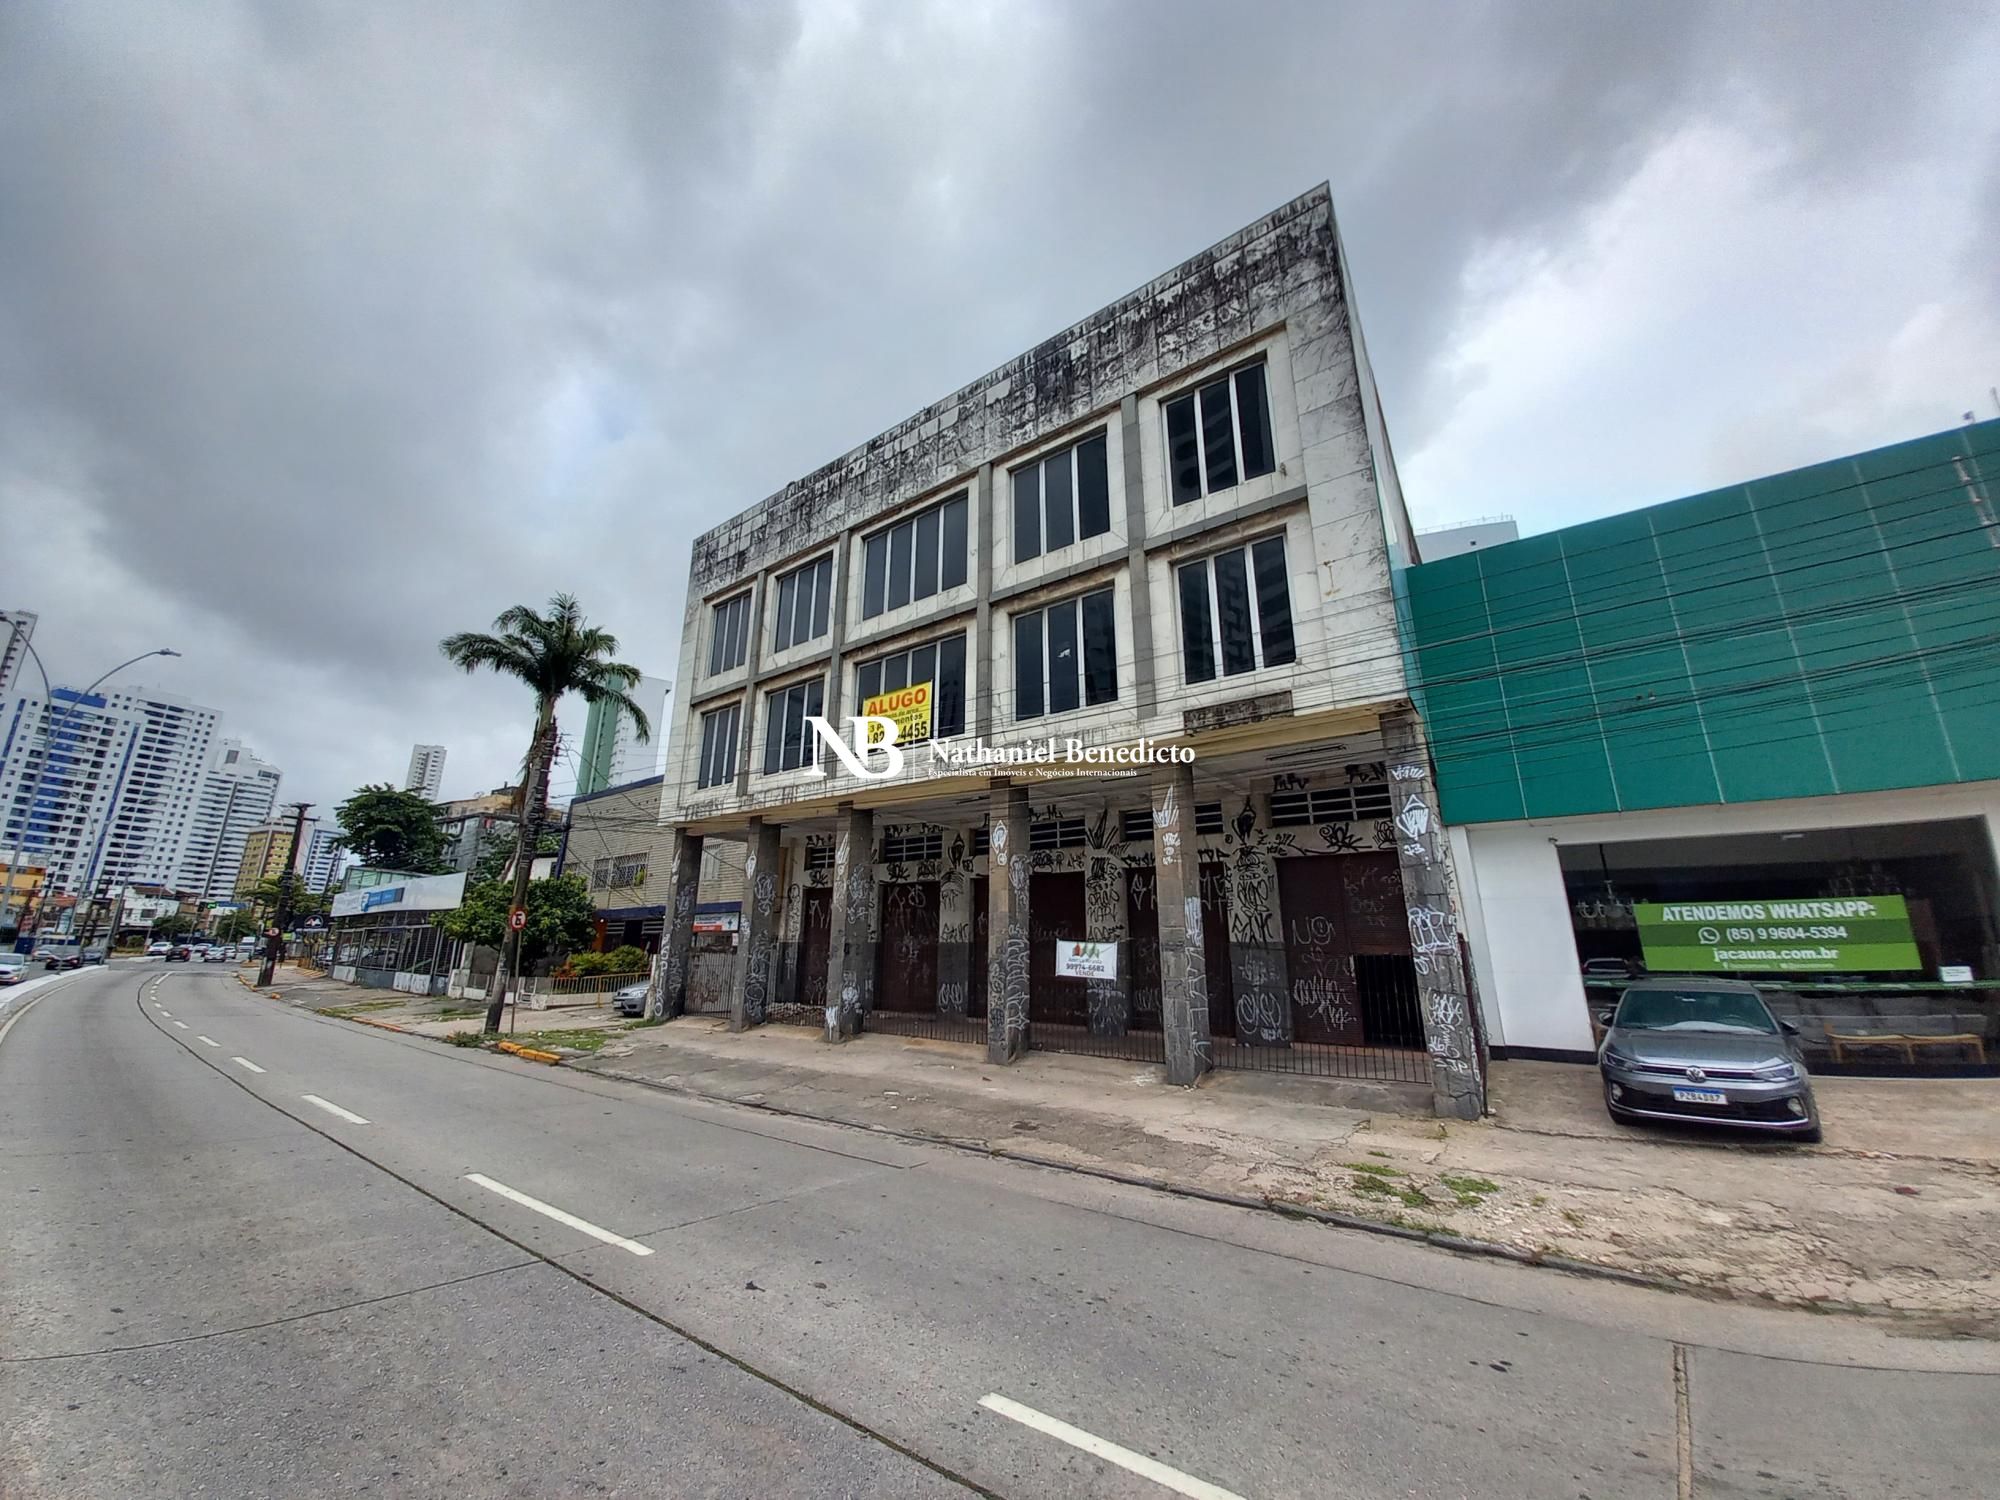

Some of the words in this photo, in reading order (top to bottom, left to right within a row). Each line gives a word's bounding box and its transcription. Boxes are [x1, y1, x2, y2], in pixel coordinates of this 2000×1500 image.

[867, 687, 927, 717] ALUGO
[1662, 903, 1766, 922] ATENDEMOS
[1768, 900, 1877, 920] WHATSAPP:
[1726, 928, 1755, 943] (85)
[1768, 926, 1848, 940] 9604-5394
[1713, 947, 1838, 963] jacauna.com.br
